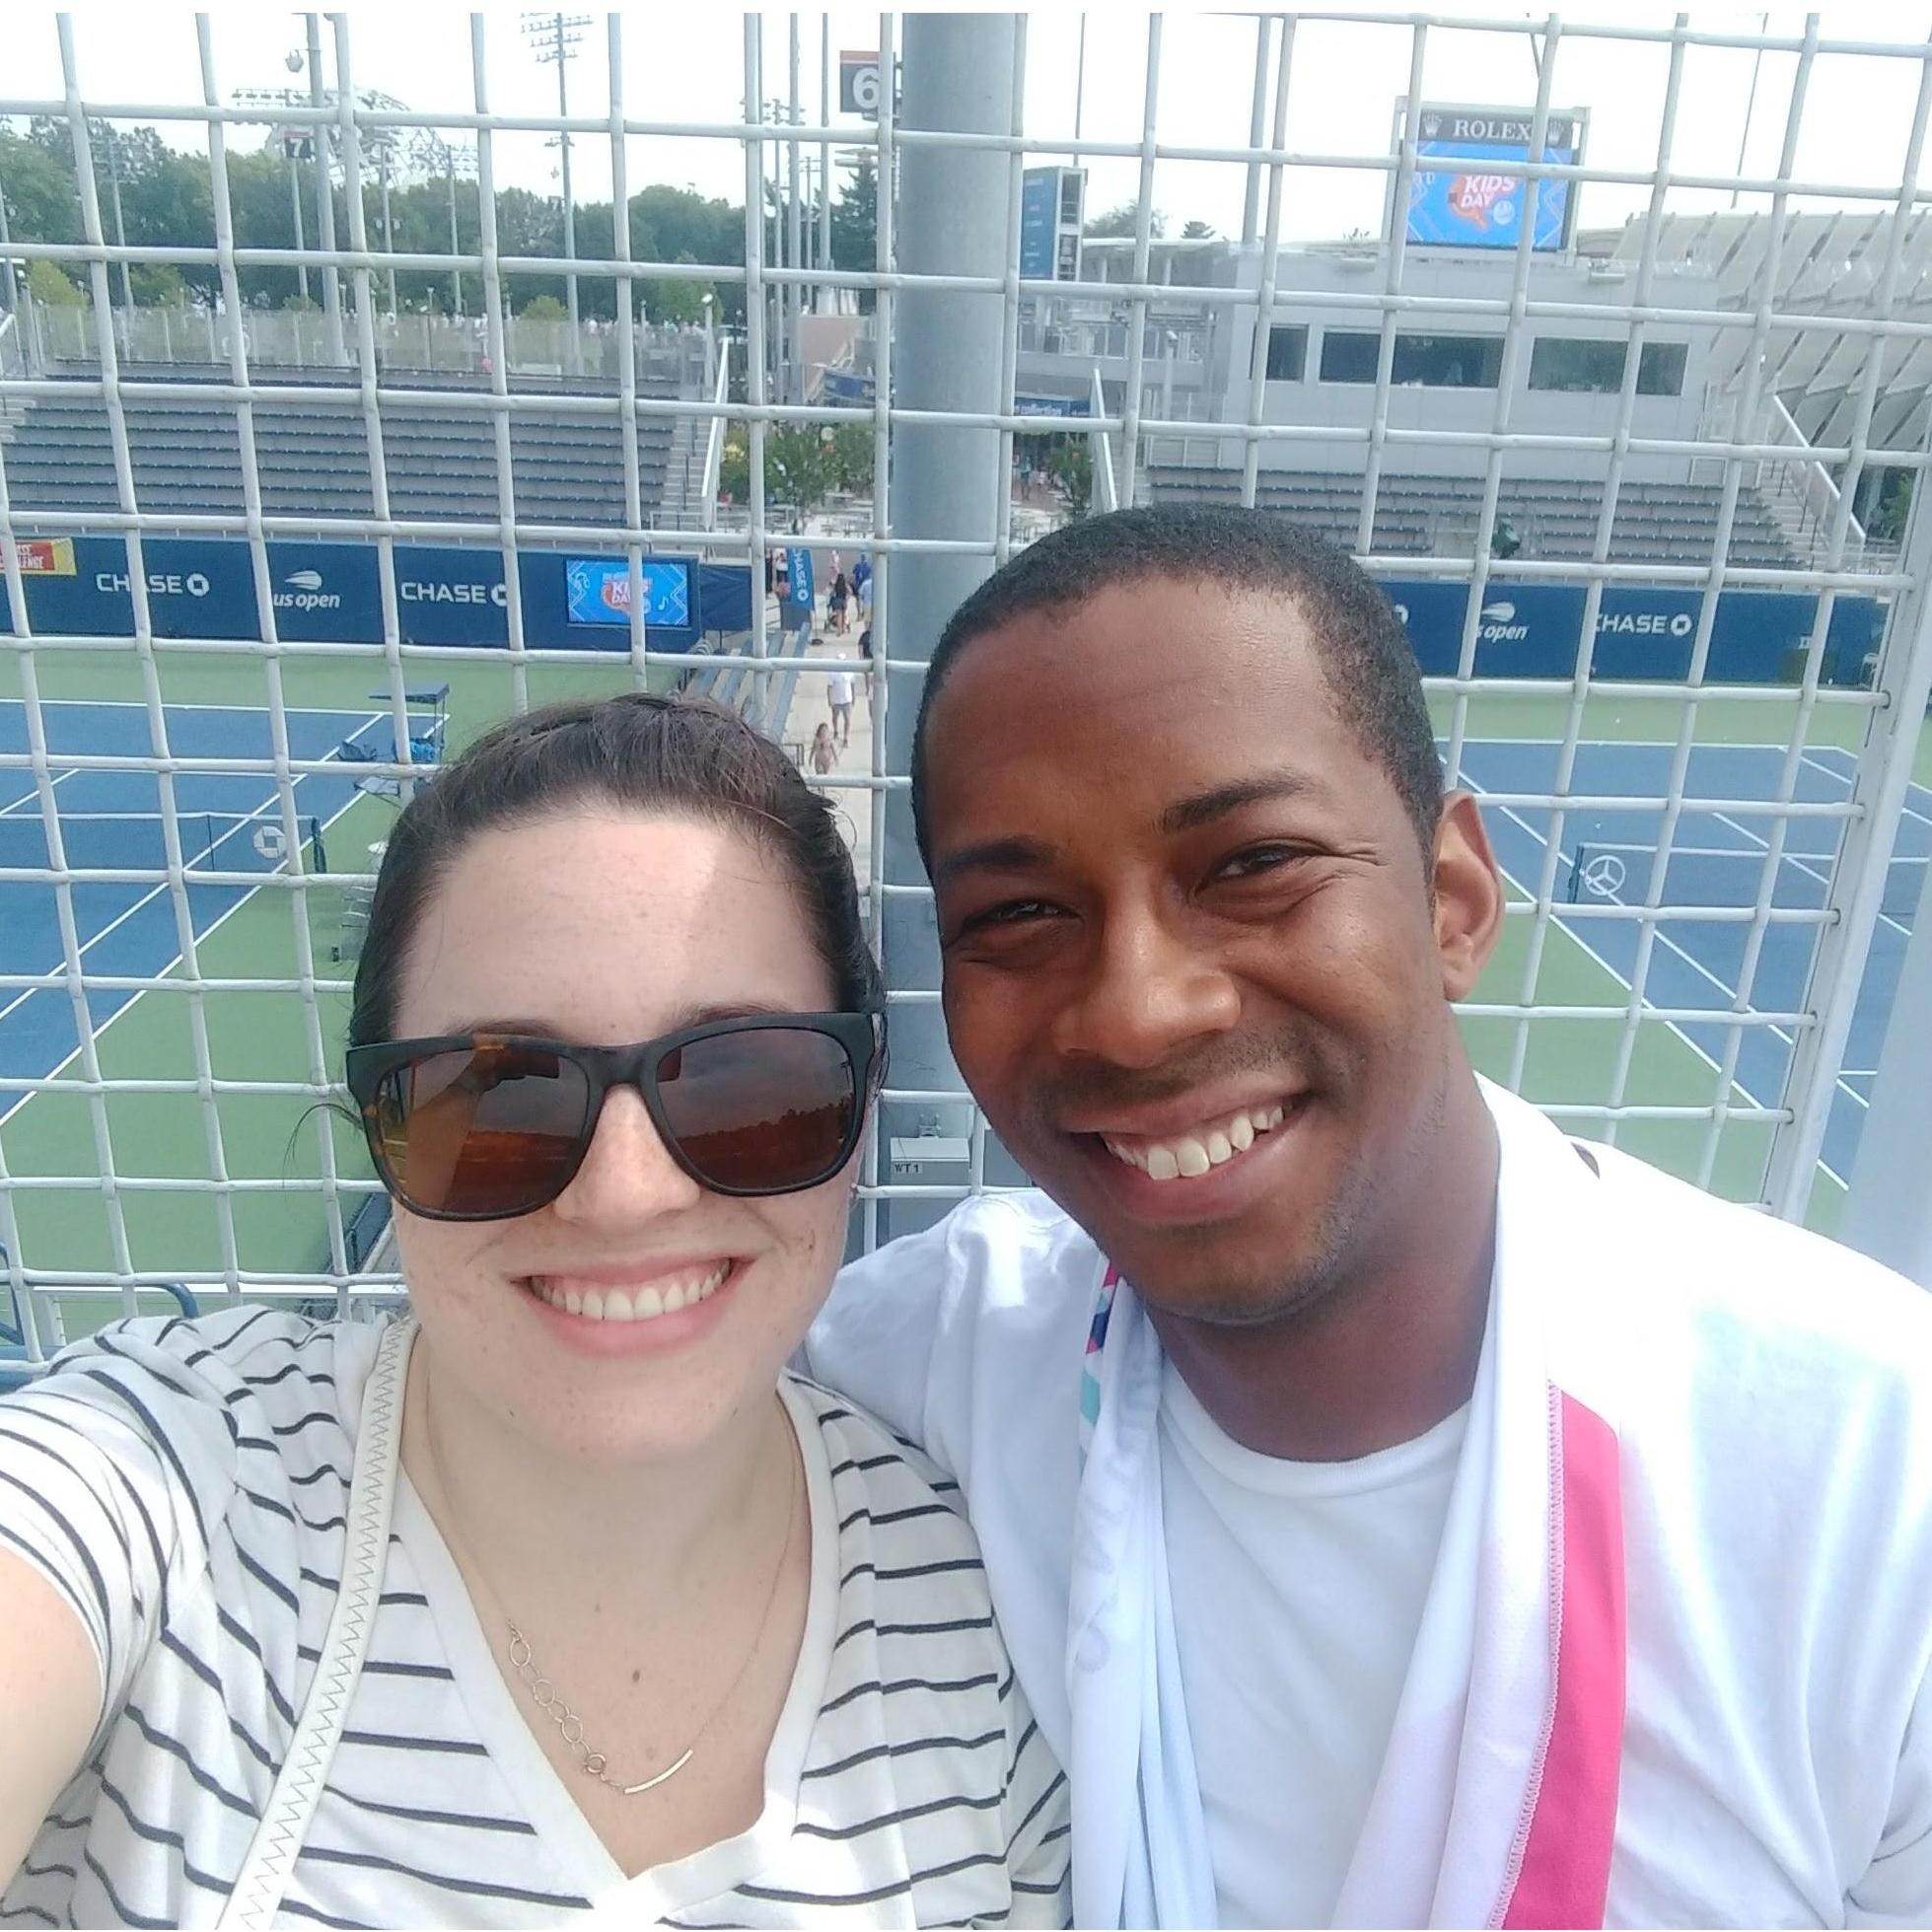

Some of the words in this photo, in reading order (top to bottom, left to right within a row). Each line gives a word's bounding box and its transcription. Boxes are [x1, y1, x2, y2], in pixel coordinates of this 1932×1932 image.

[853, 66, 881, 109] 6
[1453, 119, 1532, 140] ROLEX
[289, 137, 303, 157] 7
[1464, 175, 1516, 193] KIDS
[1461, 192, 1496, 208] DAY
[96, 573, 183, 594] CHSE
[273, 593, 294, 608] us
[296, 594, 340, 611] open
[400, 582, 487, 605] CHASE
[1483, 625, 1530, 644] open
[894, 1163, 911, 1173] WT
[913, 1164, 919, 1173] 1
